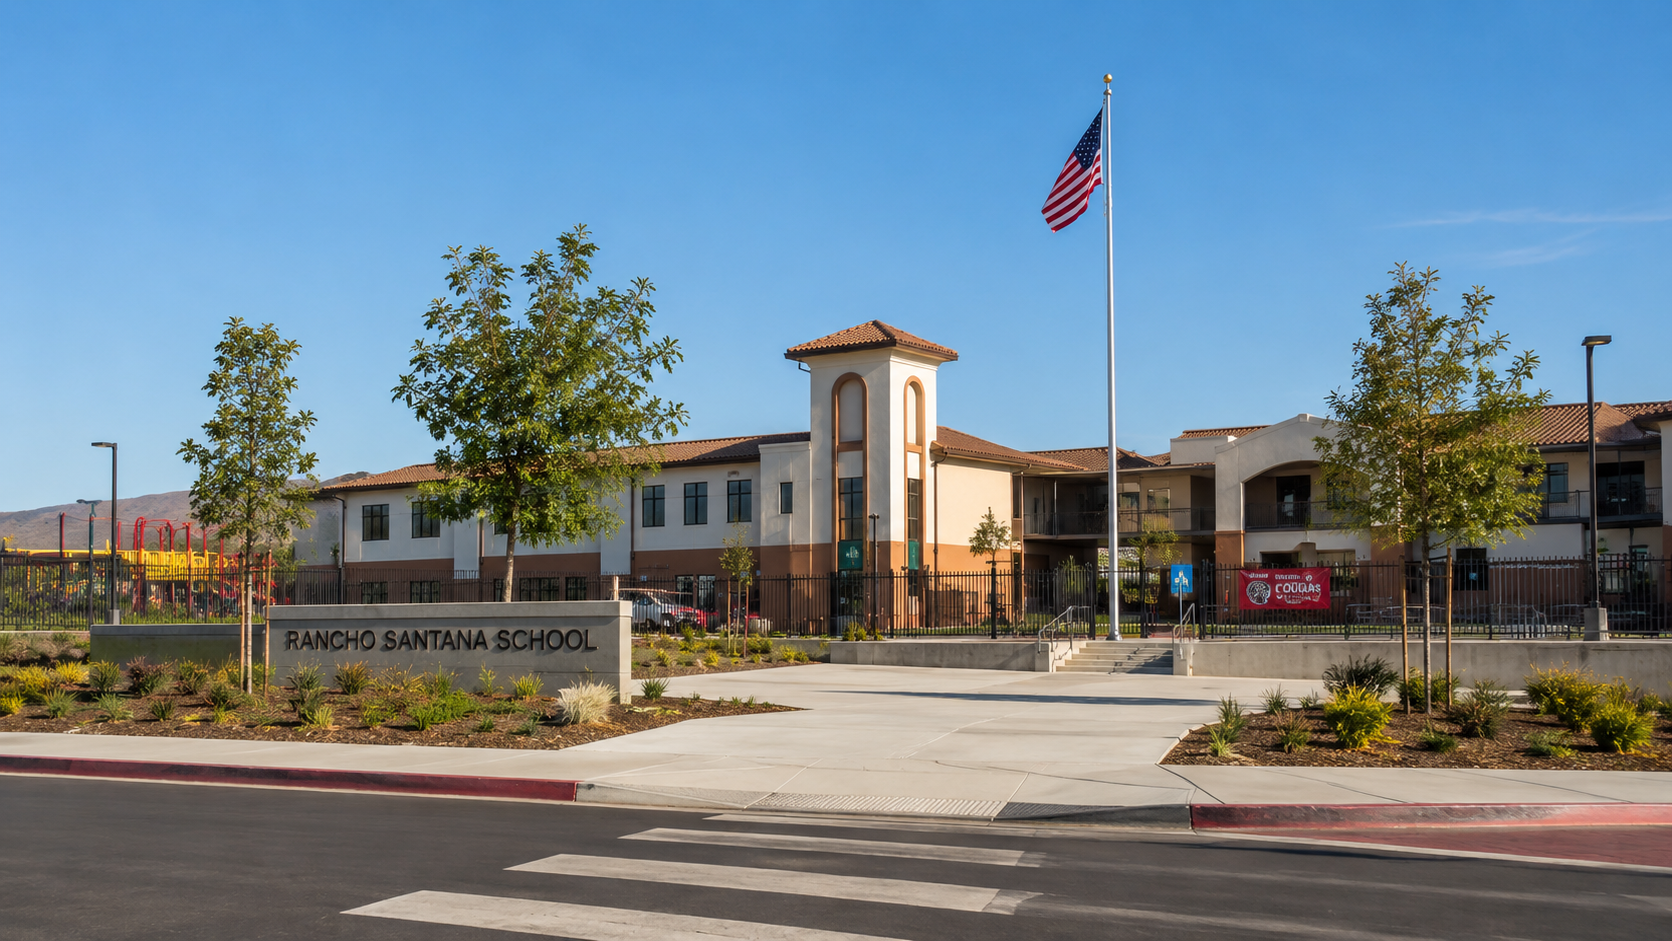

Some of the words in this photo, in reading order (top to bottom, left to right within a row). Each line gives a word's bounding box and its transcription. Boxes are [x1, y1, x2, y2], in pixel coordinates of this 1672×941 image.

[287, 629, 376, 651] RANCHO
[384, 629, 489, 651] SANTANA
[497, 629, 598, 651] SCHOOL
